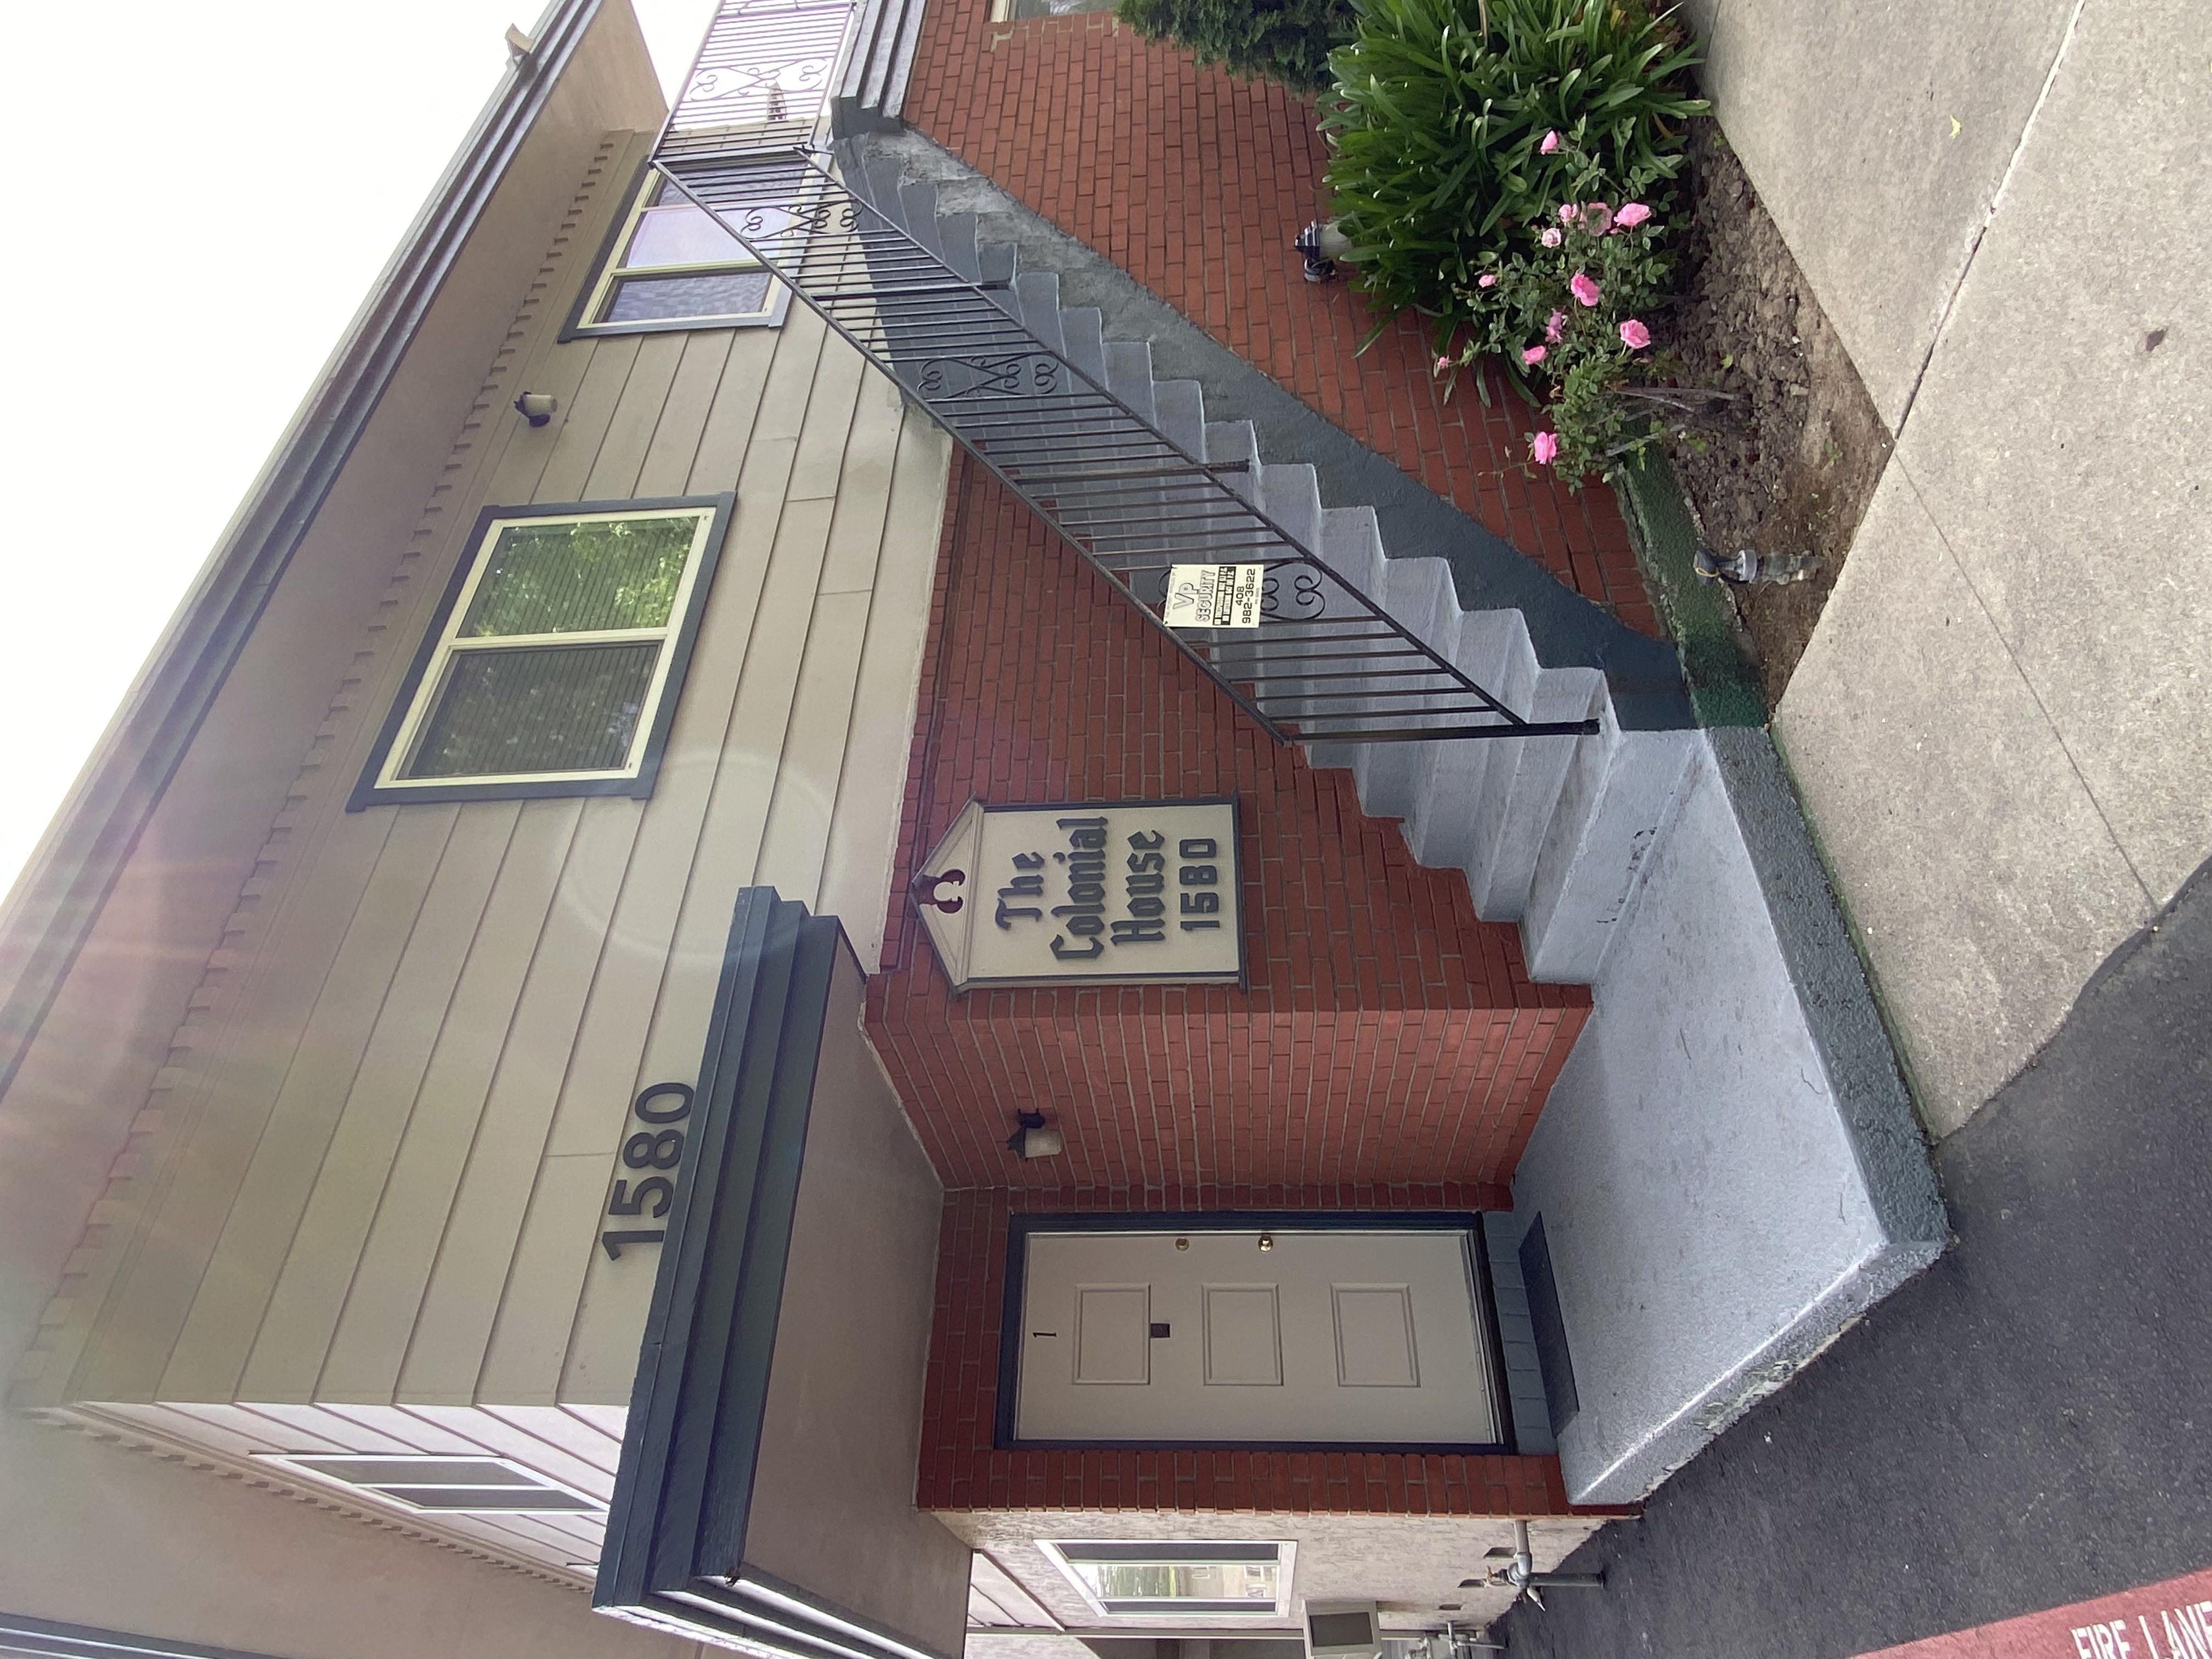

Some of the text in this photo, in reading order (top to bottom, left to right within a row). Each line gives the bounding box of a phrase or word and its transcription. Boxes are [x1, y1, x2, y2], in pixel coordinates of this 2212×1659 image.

[1173, 583, 1199, 610] VP
[1195, 569, 1216, 622] SECURITY
[1235, 586, 1244, 606] 408
[1242, 568, 1255, 624] 982-3622
[995, 851, 1045, 930] The
[1049, 816, 1108, 960] Colonial
[1110, 830, 1165, 946] House
[1179, 838, 1220, 932] 1580
[602, 1082, 695, 1261] 1580
[2071, 1619, 2131, 1659] FIRE
